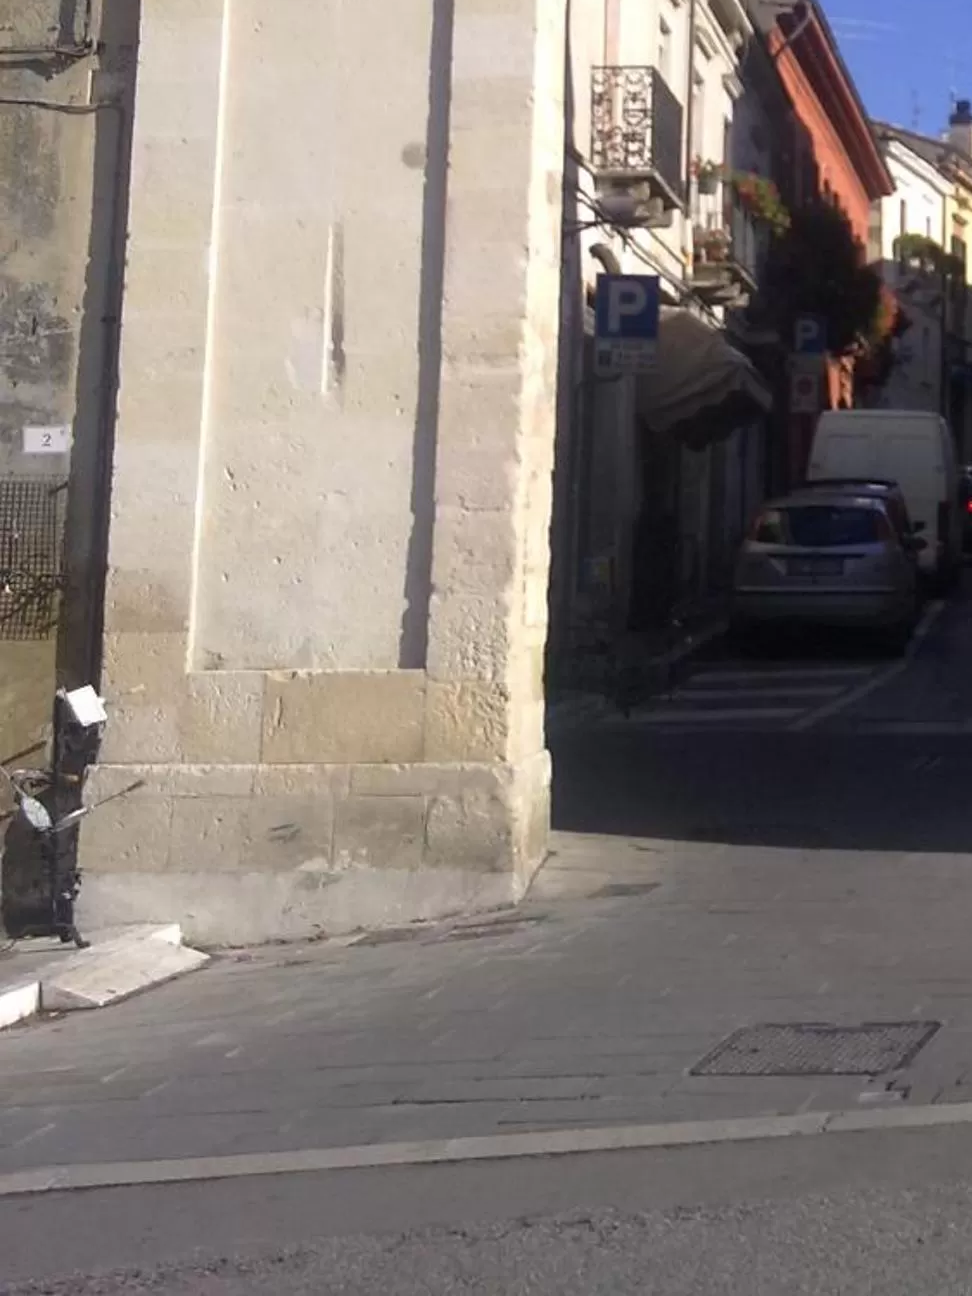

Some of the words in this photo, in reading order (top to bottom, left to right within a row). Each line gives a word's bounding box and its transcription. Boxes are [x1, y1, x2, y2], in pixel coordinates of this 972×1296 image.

[607, 280, 648, 333] P
[794, 317, 820, 352] P
[41, 433, 52, 447] 2
